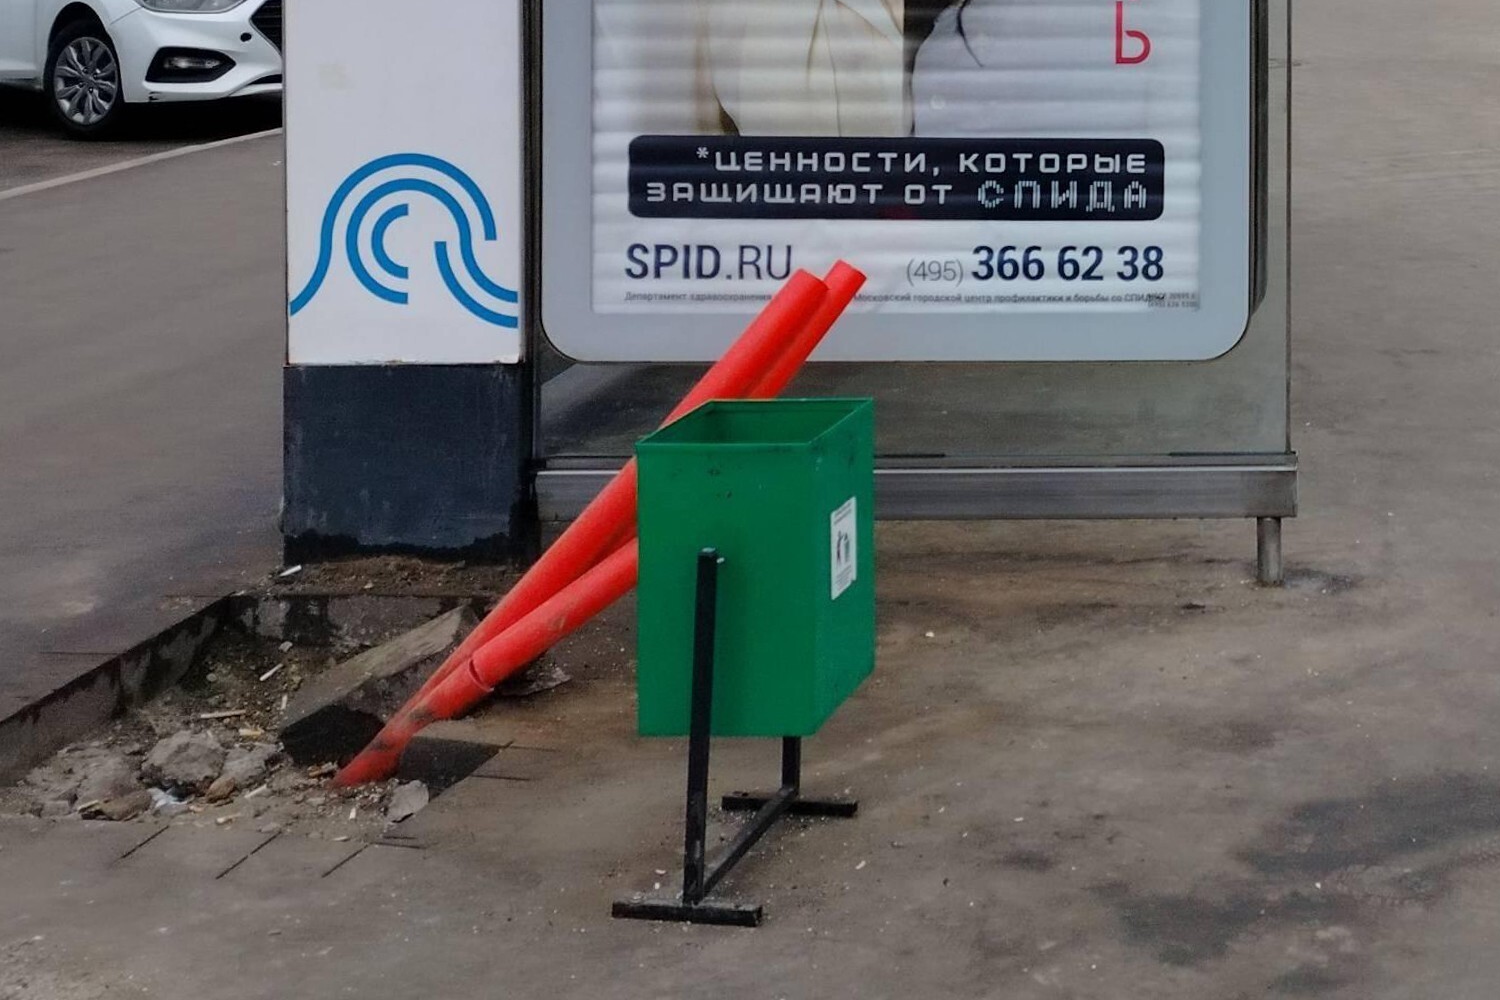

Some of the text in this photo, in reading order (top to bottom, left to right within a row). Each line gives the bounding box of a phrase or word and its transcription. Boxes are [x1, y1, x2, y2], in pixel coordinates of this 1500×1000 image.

[959, 153, 1146, 174] КОТОРЫЕ
[646, 180, 1148, 213] ЗАЩИЩАЮТ ОТ СПИДА
[625, 243, 793, 281] SPID.RU
[906, 245, 1165, 288] (495) 366 62 38
